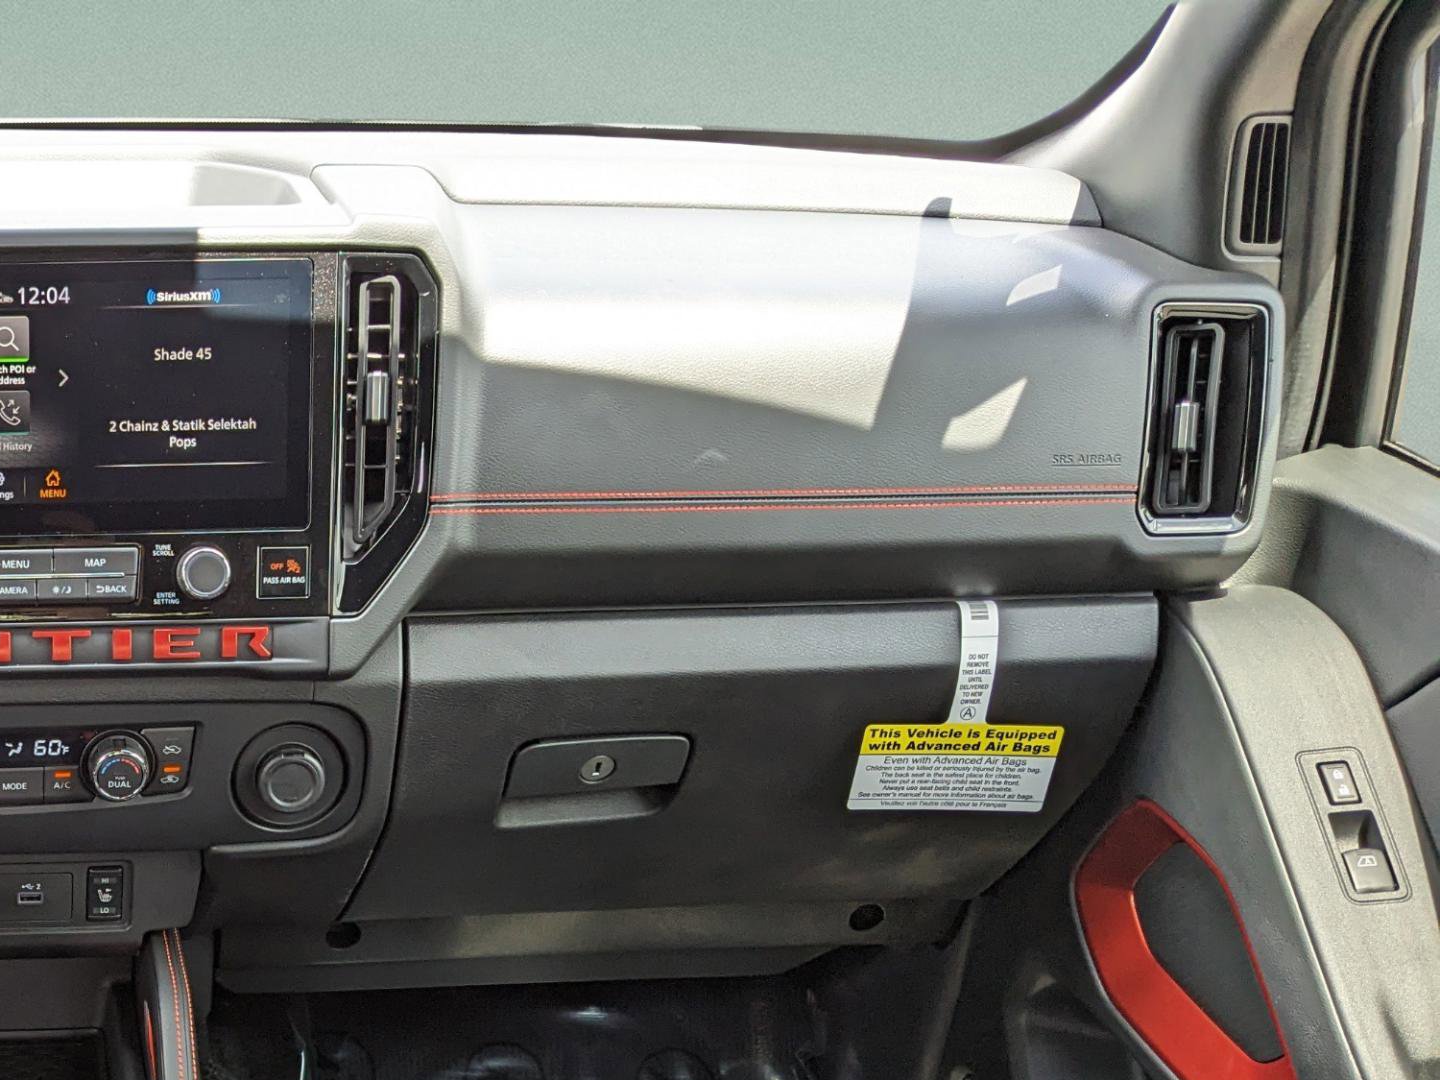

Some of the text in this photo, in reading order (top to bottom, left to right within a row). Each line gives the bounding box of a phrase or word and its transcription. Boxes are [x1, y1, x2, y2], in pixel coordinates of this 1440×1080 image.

[18, 286, 71, 305] 12:04
[154, 348, 212, 361] Shade 45
[10, 365, 25, 374] POI
[26, 365, 36, 374] or
[109, 418, 257, 432] 2 Chainz & Statik Selektah
[3, 442, 32, 452] History
[169, 436, 197, 450] Pops
[1052, 453, 1122, 464] SRS AIRBAG
[40, 489, 67, 498] MENU
[2, 560, 30, 569] MENU
[85, 558, 106, 568] MAP
[105, 585, 127, 593] BACK
[870, 729, 901, 738] This
[907, 729, 962, 738] Vehicle
[986, 729, 1057, 740] Equipped
[869, 741, 1050, 754] with Advanced Air Bags
[884, 756, 1027, 767] Even with Advanced Air Bags
